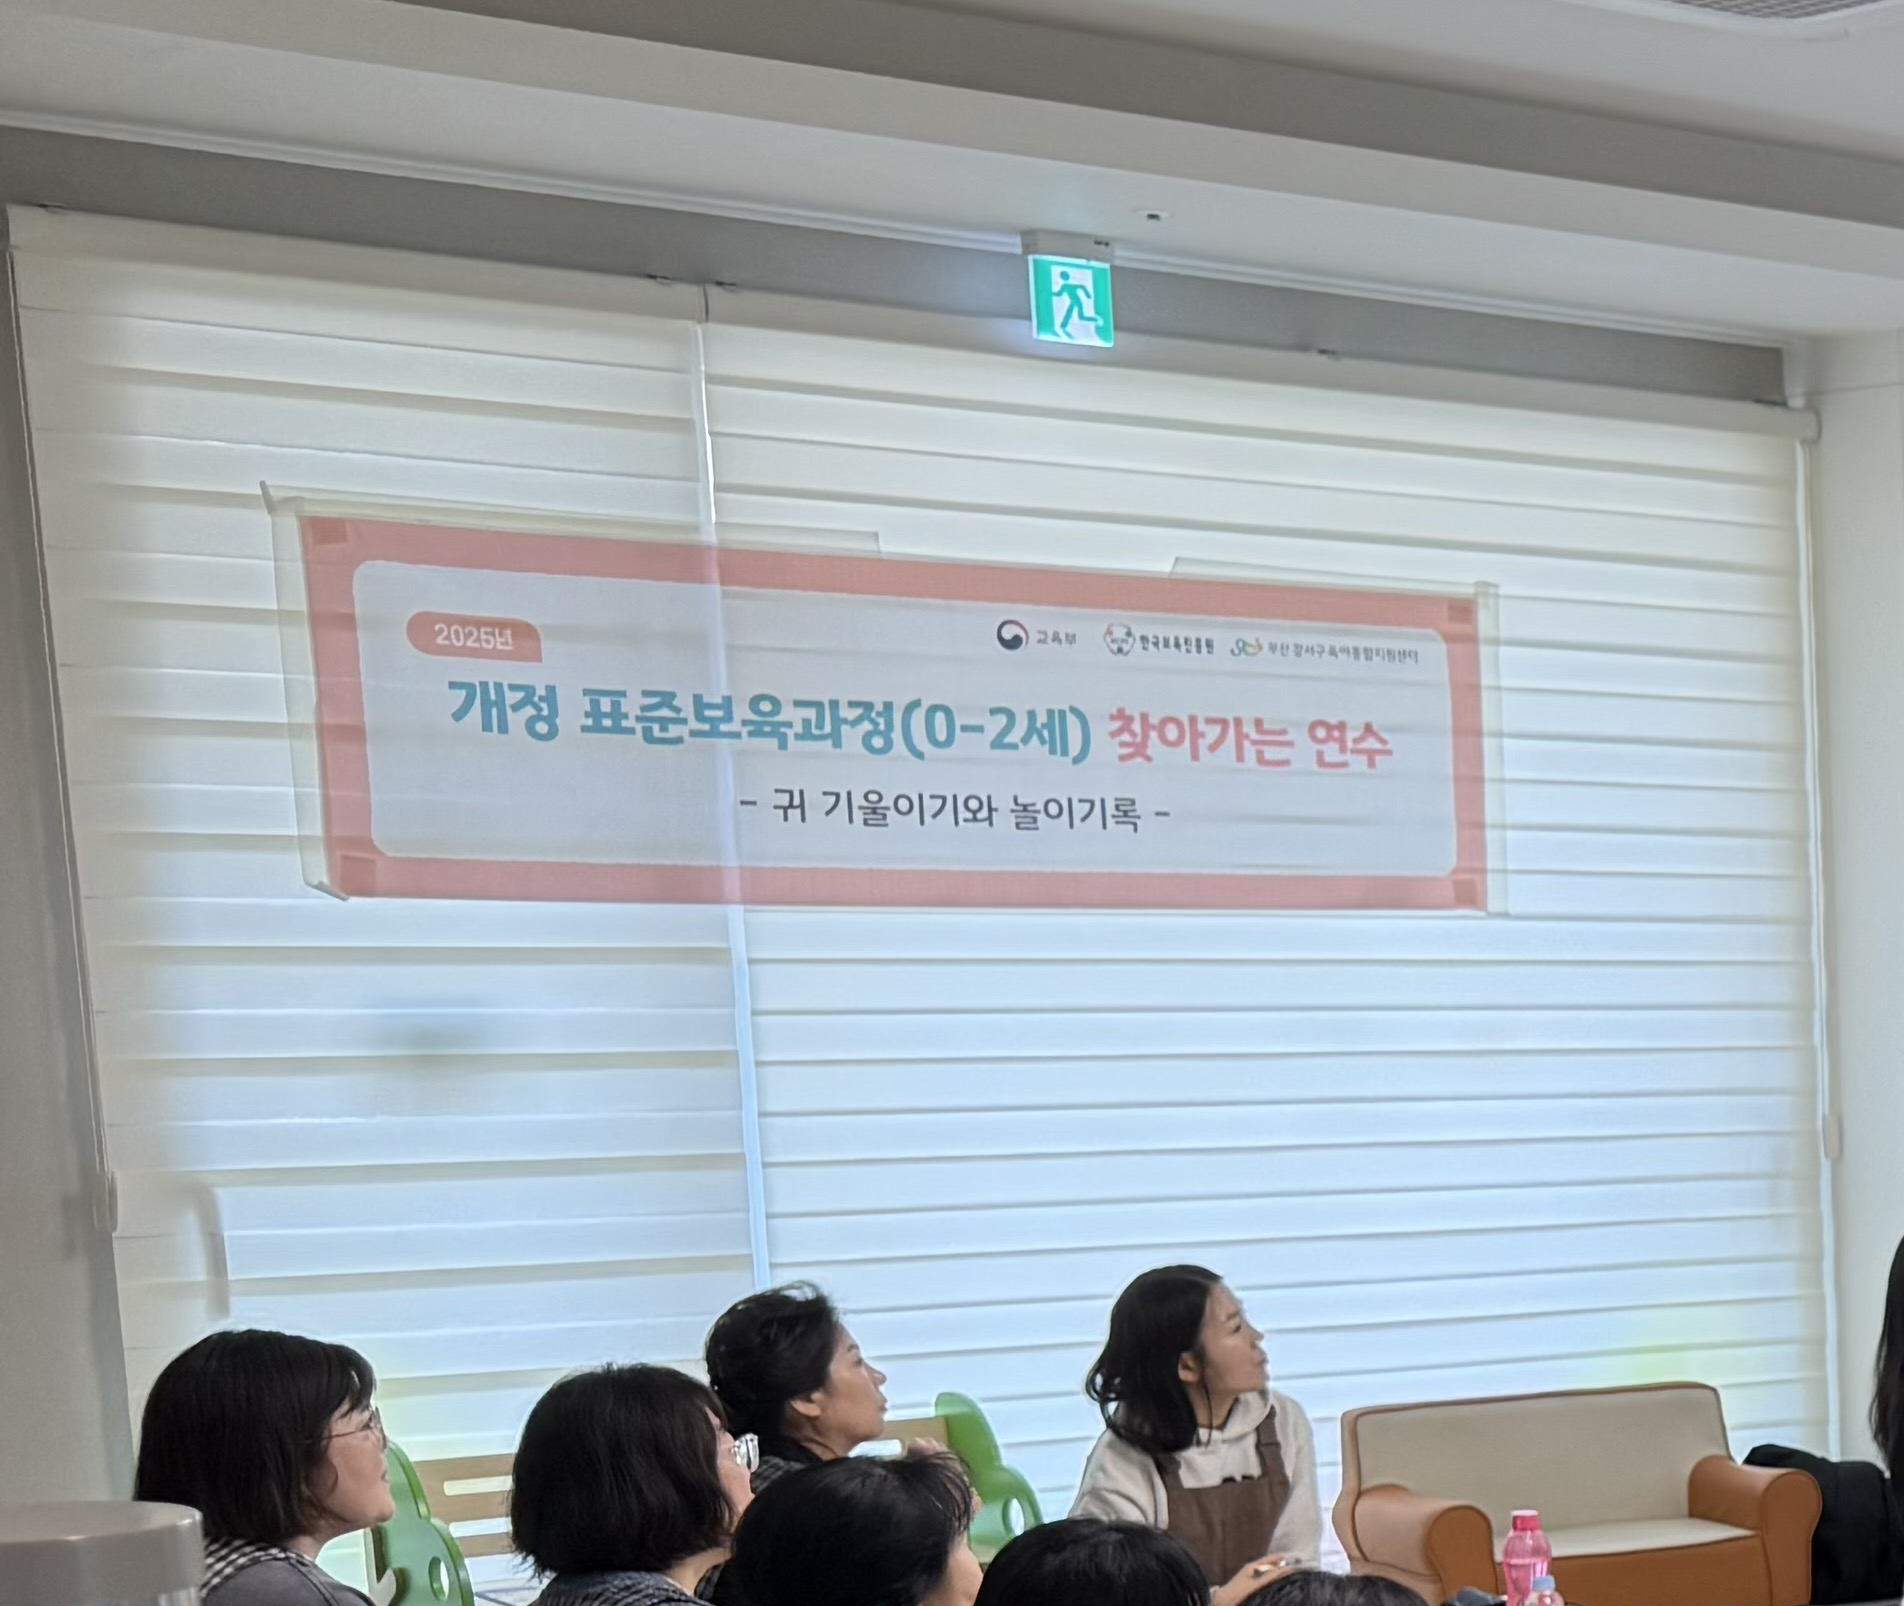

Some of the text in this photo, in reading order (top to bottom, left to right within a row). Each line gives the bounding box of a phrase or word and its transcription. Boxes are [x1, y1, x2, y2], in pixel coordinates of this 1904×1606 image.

[434, 622, 513, 654] 2025년
[1036, 629, 1077, 647] 교육부
[447, 677, 1394, 769] 개정 표준보육과정(0-2세) 찾아가는 연수
[772, 788, 808, 826] 귀
[822, 788, 999, 830] 기울이기와
[1010, 795, 1142, 834] 놀이기록
